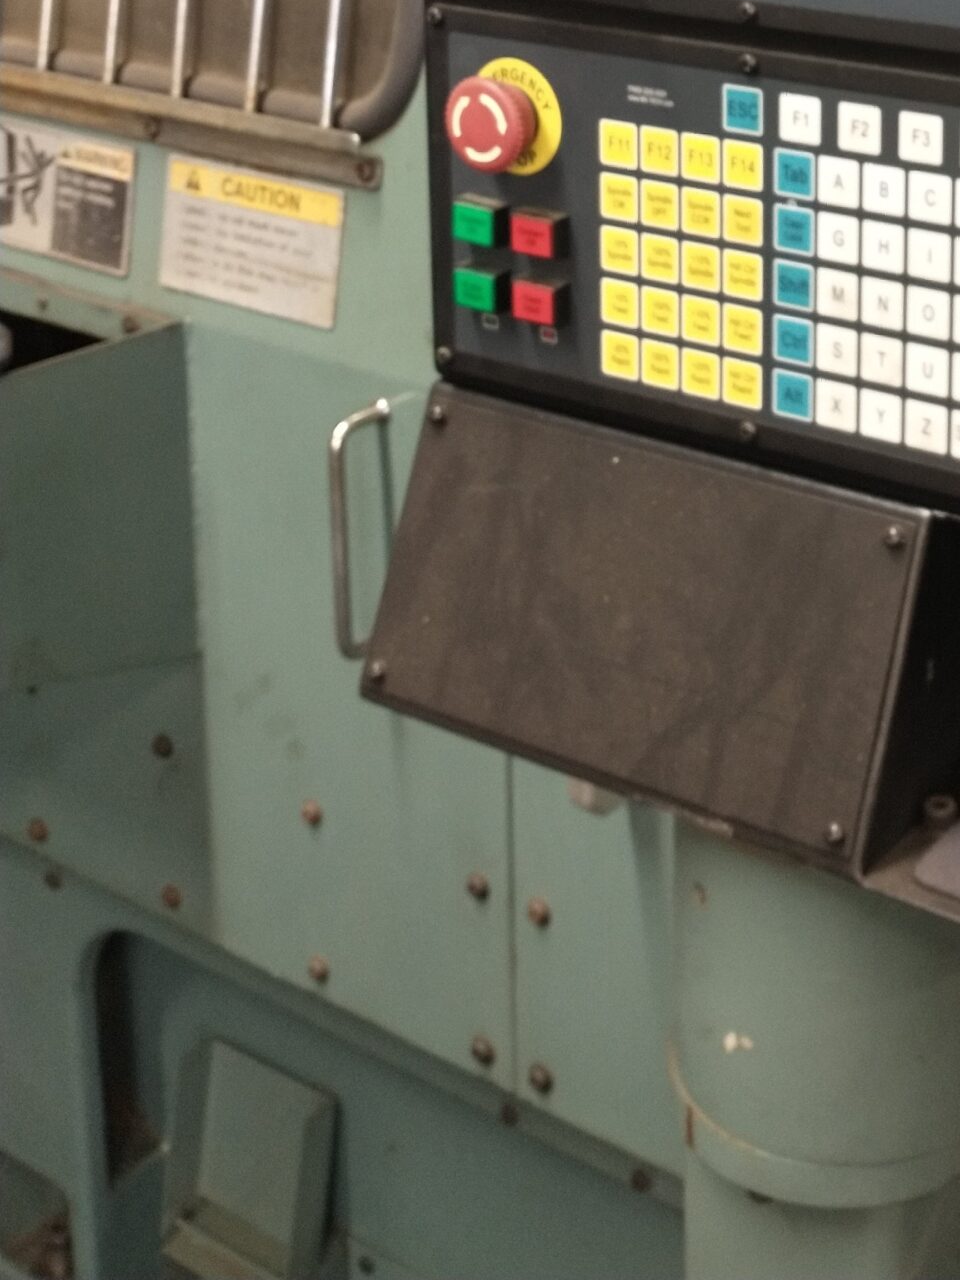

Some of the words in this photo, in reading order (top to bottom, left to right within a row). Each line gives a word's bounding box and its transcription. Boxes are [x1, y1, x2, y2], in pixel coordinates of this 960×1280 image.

[727, 98, 760, 122] ESC
[791, 109, 809, 127] F1
[850, 118, 870, 139] F2
[911, 127, 931, 148] F3
[607, 135, 631, 152] F11
[646, 141, 673, 161] F12
[687, 148, 714, 168] F13
[730, 155, 756, 174] F14
[783, 163, 810, 186] Tab
[833, 173, 845, 190] A
[221, 176, 303, 214] CAUTION
[878, 180, 890, 199] B
[832, 229, 846, 248] G
[877, 239, 890, 255] H
[831, 285, 846, 304] M
[877, 295, 889, 313] N
[831, 340, 844, 360] S
[831, 397, 842, 414] X
[920, 417, 932, 438] Z
